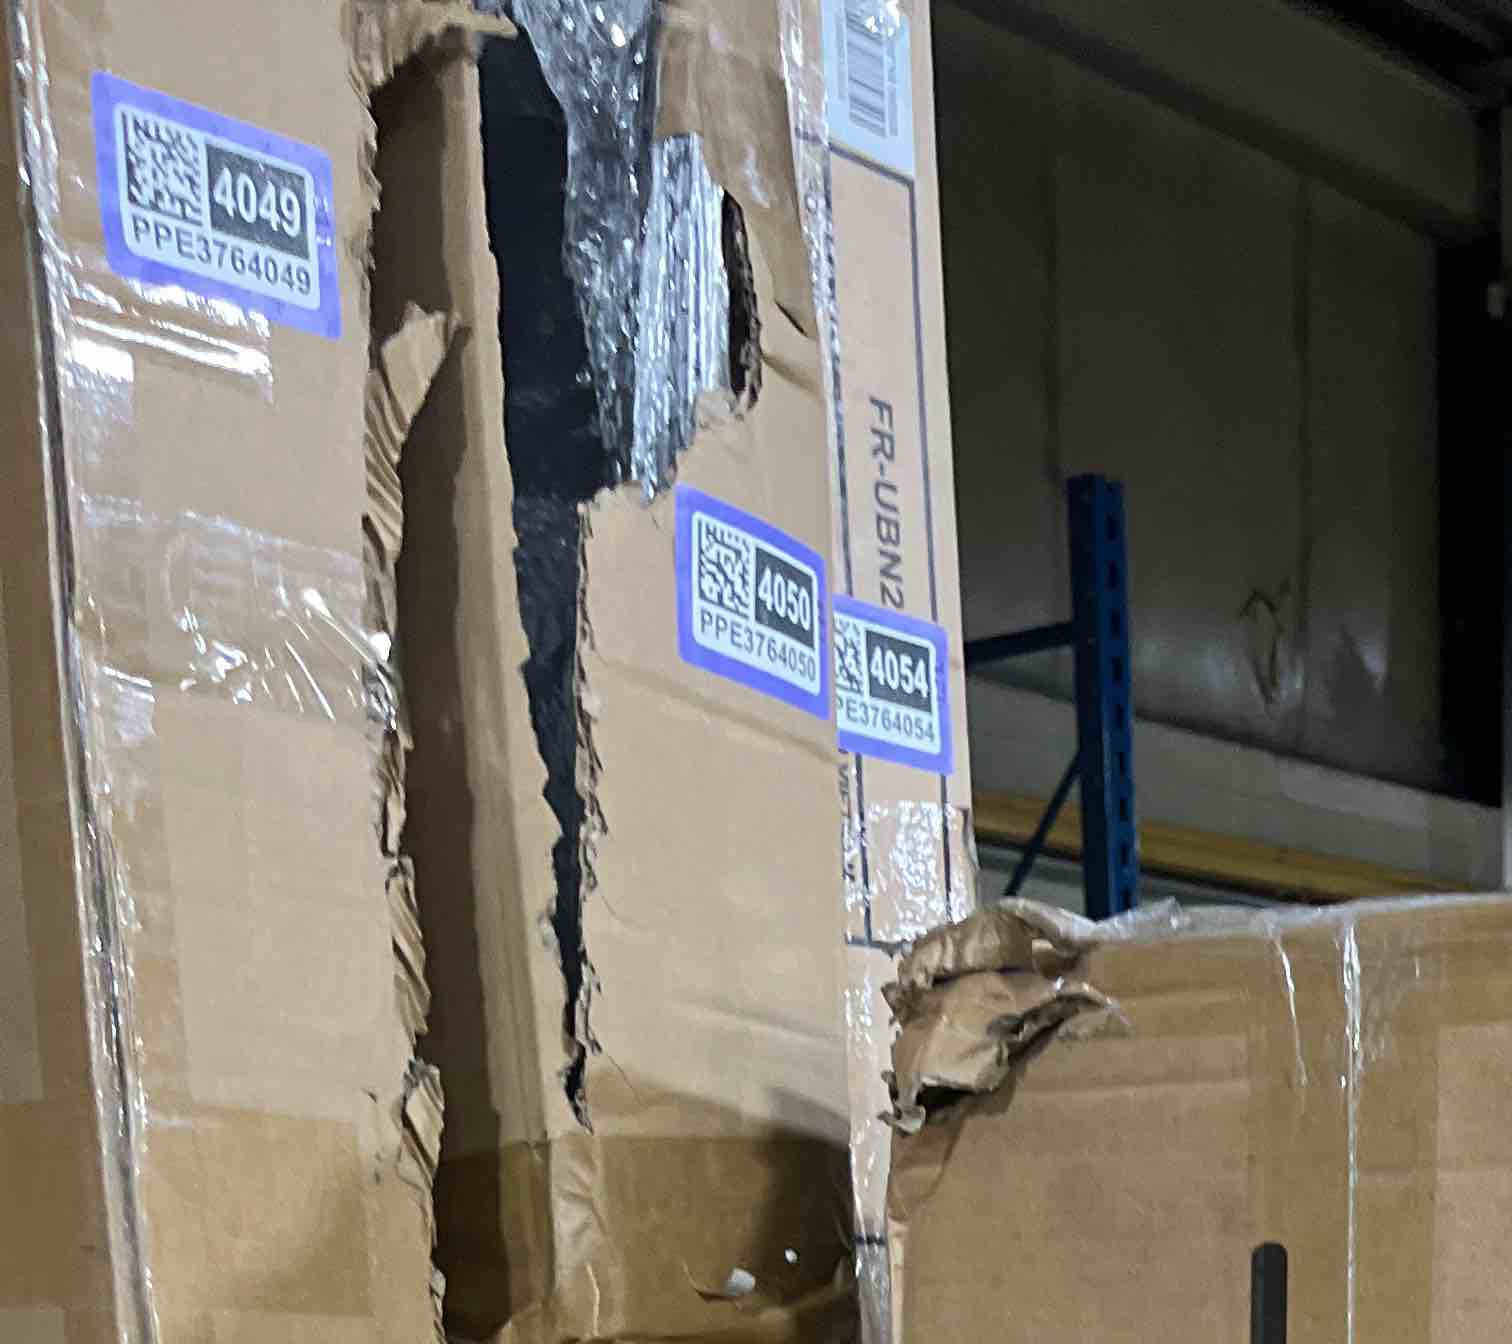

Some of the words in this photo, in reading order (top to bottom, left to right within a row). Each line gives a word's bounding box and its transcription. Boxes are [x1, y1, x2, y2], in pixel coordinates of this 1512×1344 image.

[212, 167, 301, 237] 4049
[132, 212, 312, 296] PPE3764049
[757, 566, 811, 632] 4050
[700, 610, 817, 683] PPE3764050
[870, 646, 929, 698] 4054
